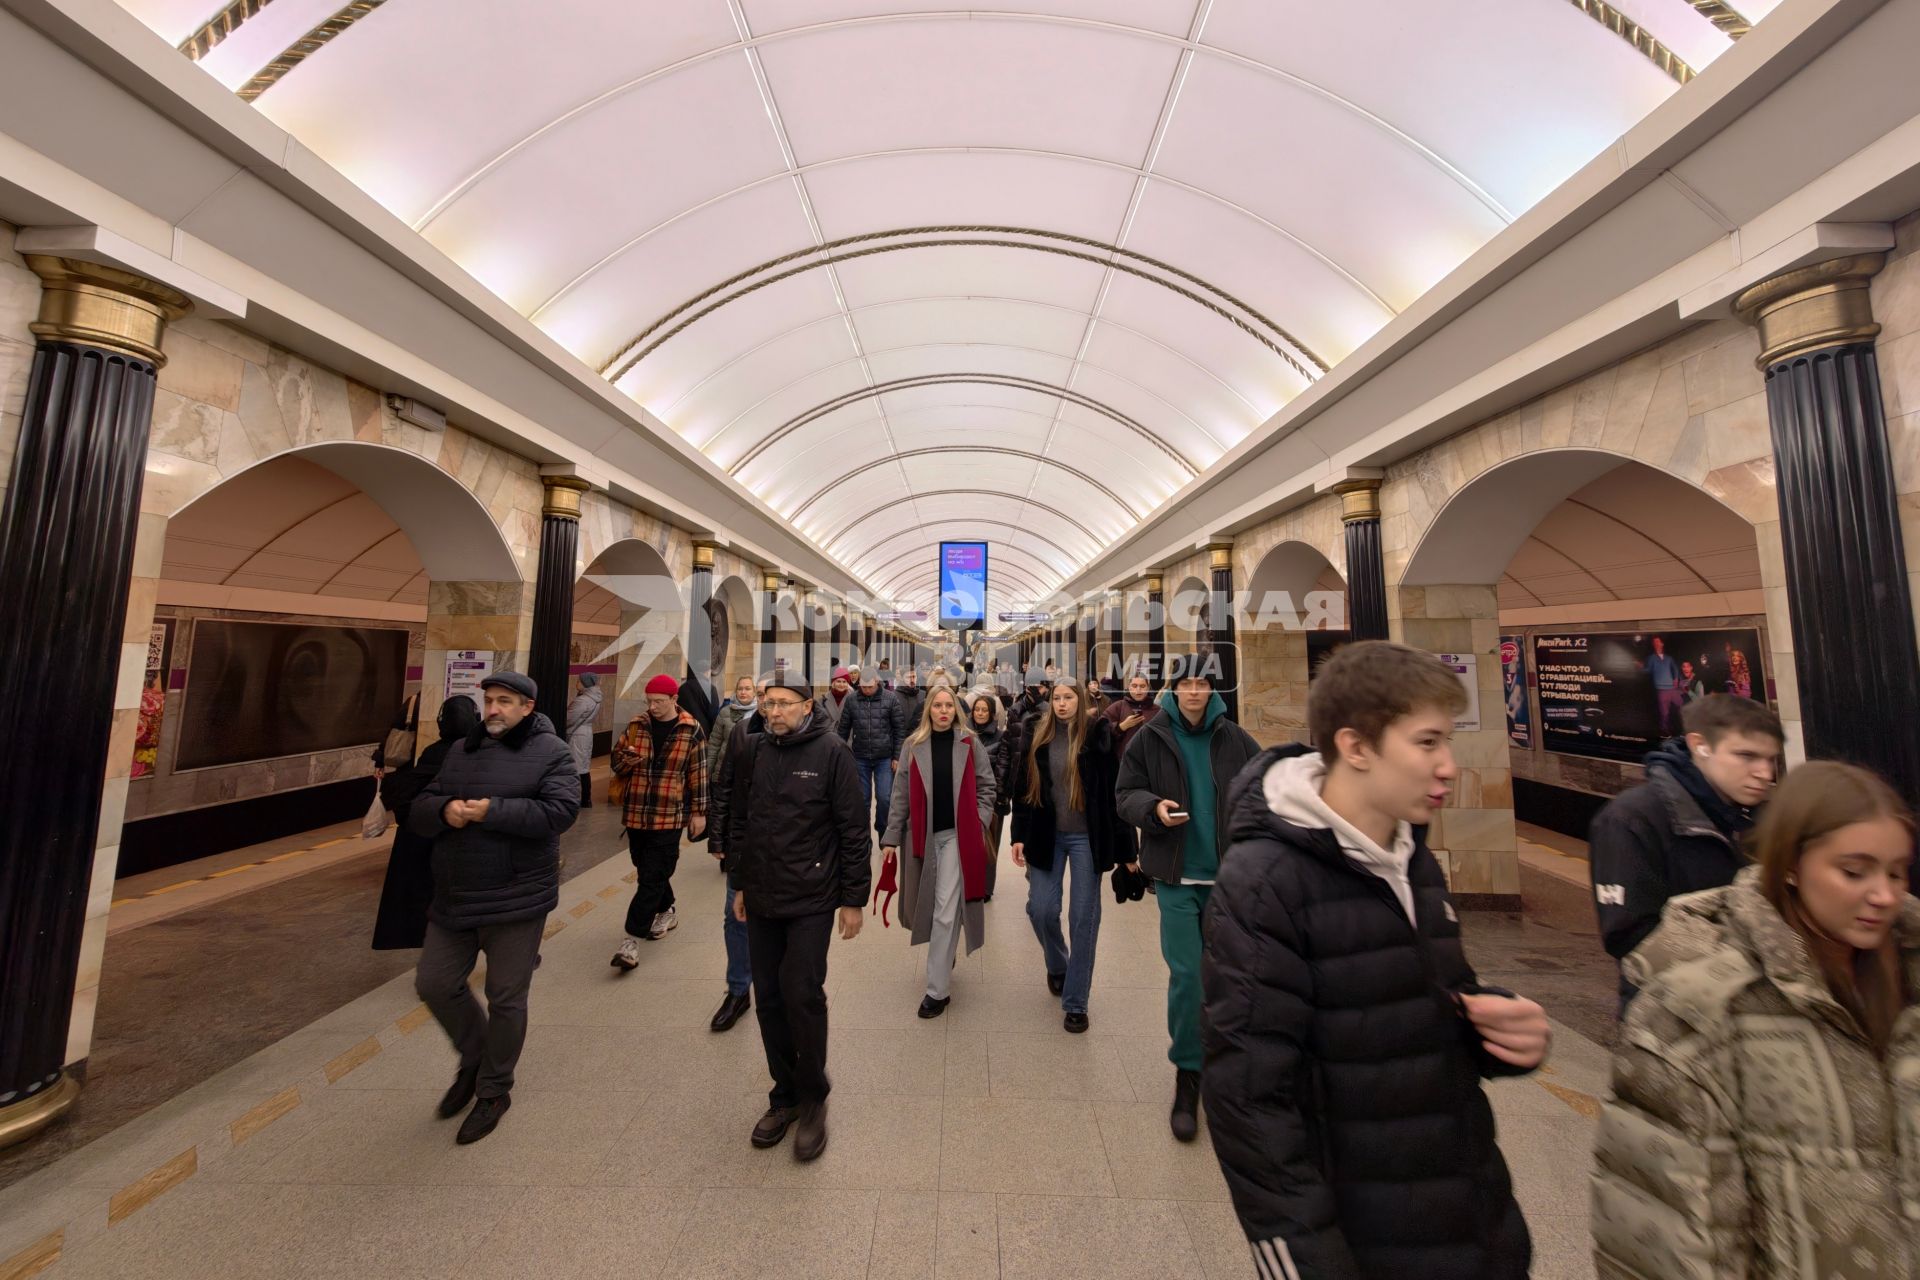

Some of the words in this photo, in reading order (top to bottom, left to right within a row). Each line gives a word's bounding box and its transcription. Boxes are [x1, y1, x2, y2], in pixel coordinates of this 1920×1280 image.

[1561, 665, 1591, 673] ЧТО-ТО
[1555, 682, 1581, 691] ЛЮДИ
[1541, 691, 1599, 702] ОТРЫВАЮТСЯ!
